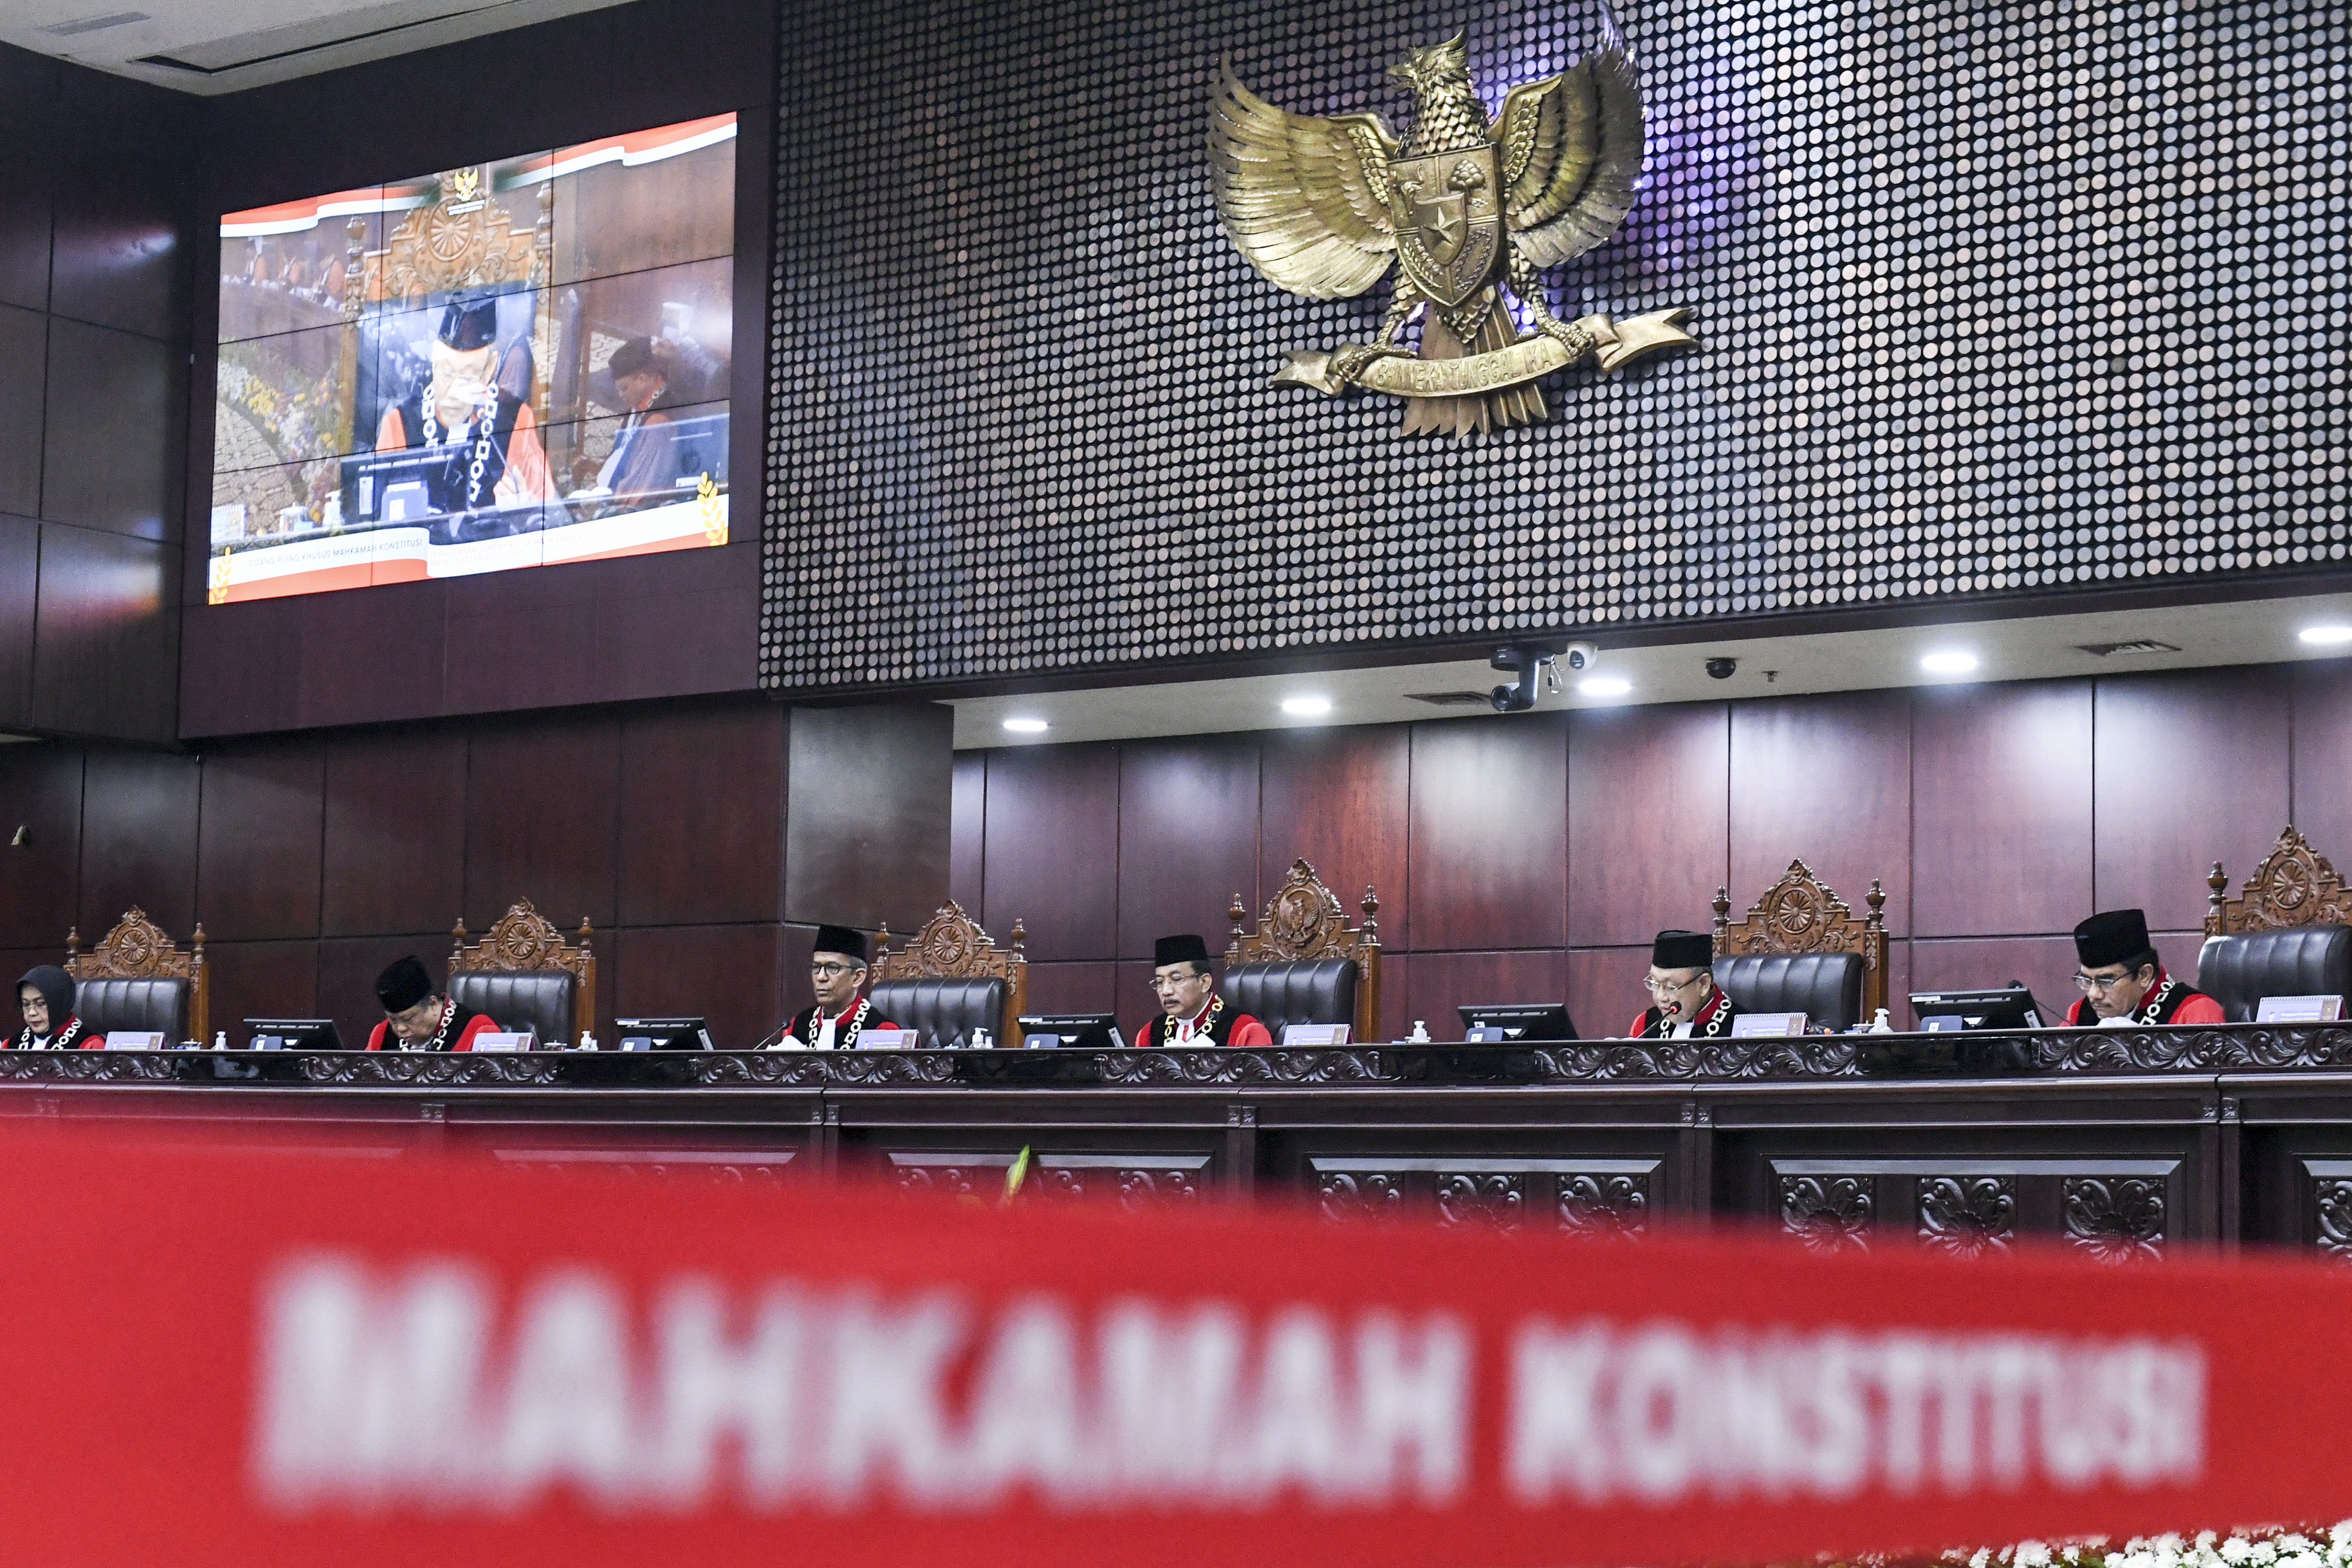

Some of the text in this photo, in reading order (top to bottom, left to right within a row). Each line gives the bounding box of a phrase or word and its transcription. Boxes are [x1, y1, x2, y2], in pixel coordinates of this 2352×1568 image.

[1450, 351, 1521, 390] TUNGGAL
[1523, 342, 1553, 374] IKA
[248, 538, 422, 567] SIDANG PLENO KHUSUS MAHKAMAH KONSTITUSI
[260, 1254, 2206, 1505] MAHKAMAH KONSTITUSI
